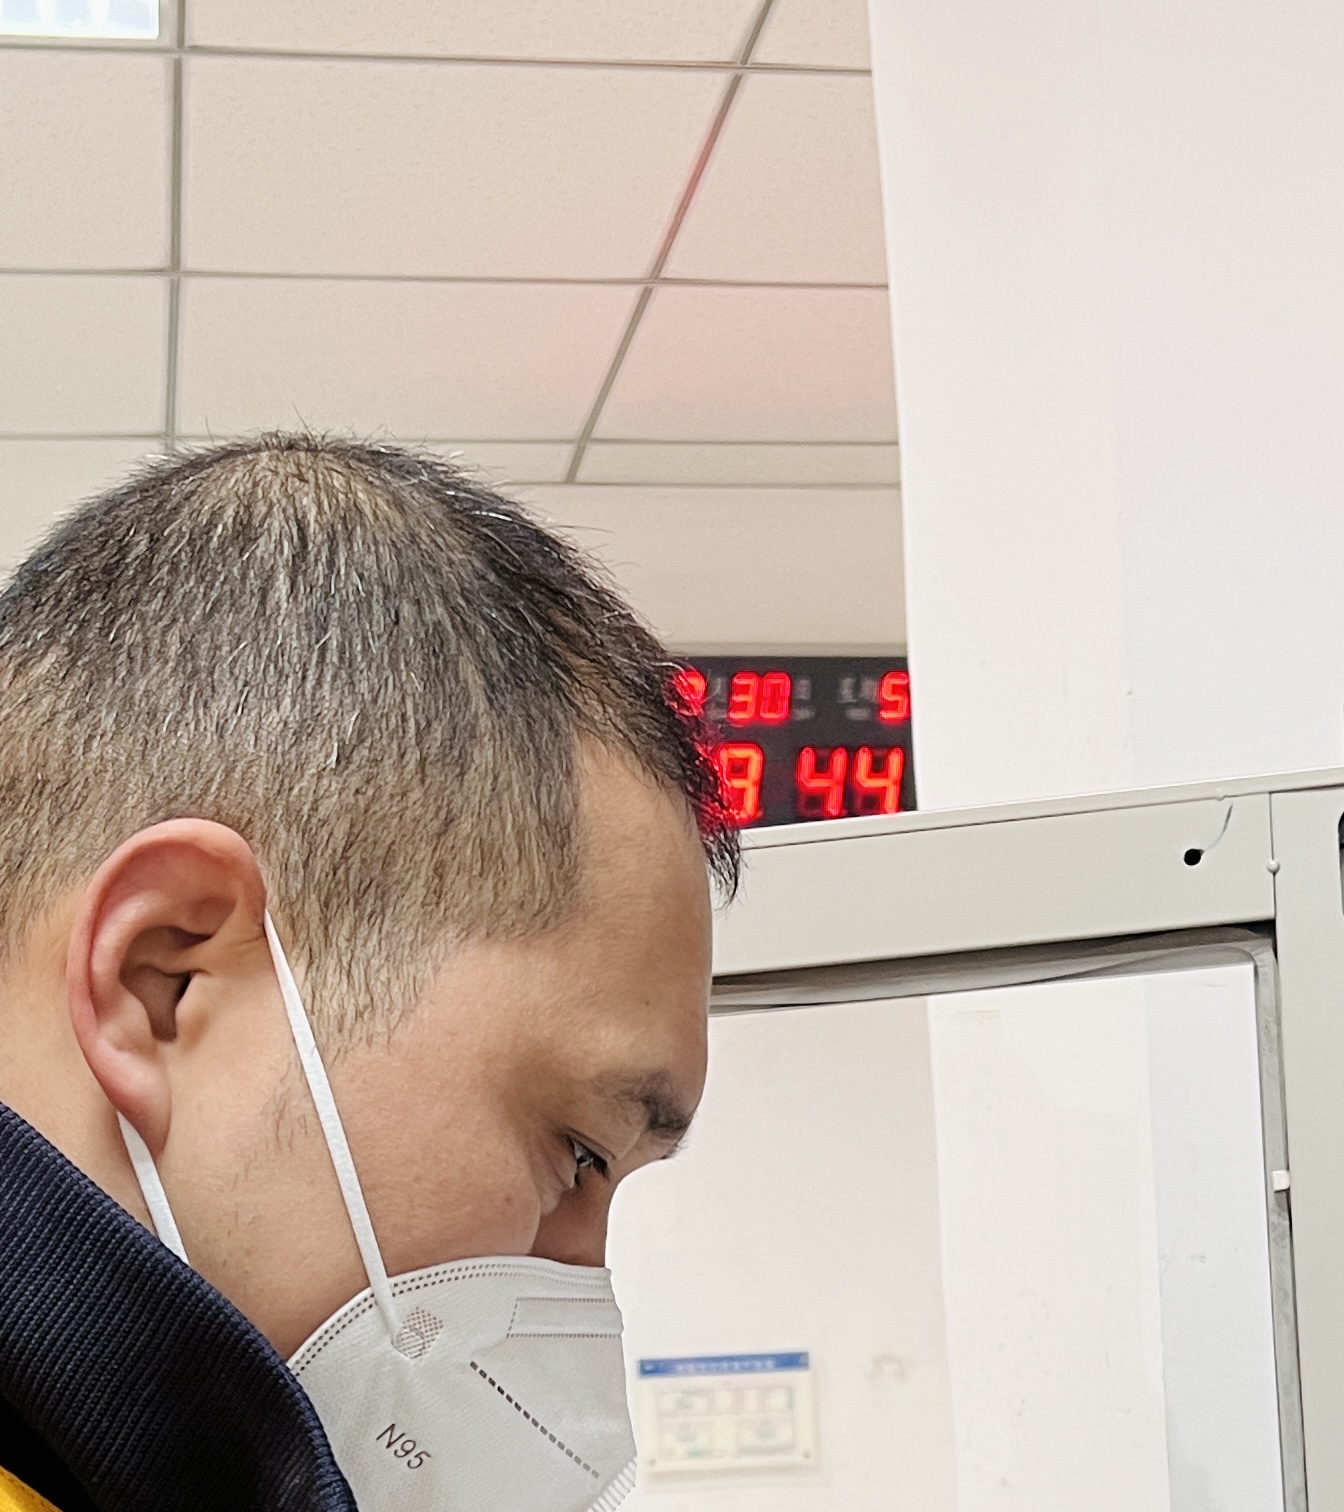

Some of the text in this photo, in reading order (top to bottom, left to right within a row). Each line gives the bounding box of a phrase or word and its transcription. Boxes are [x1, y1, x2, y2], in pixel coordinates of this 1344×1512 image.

[729, 671, 791, 724] 30
[880, 671, 910, 723] 5
[796, 746, 905, 816] 44
[375, 1422, 432, 1470] N95
